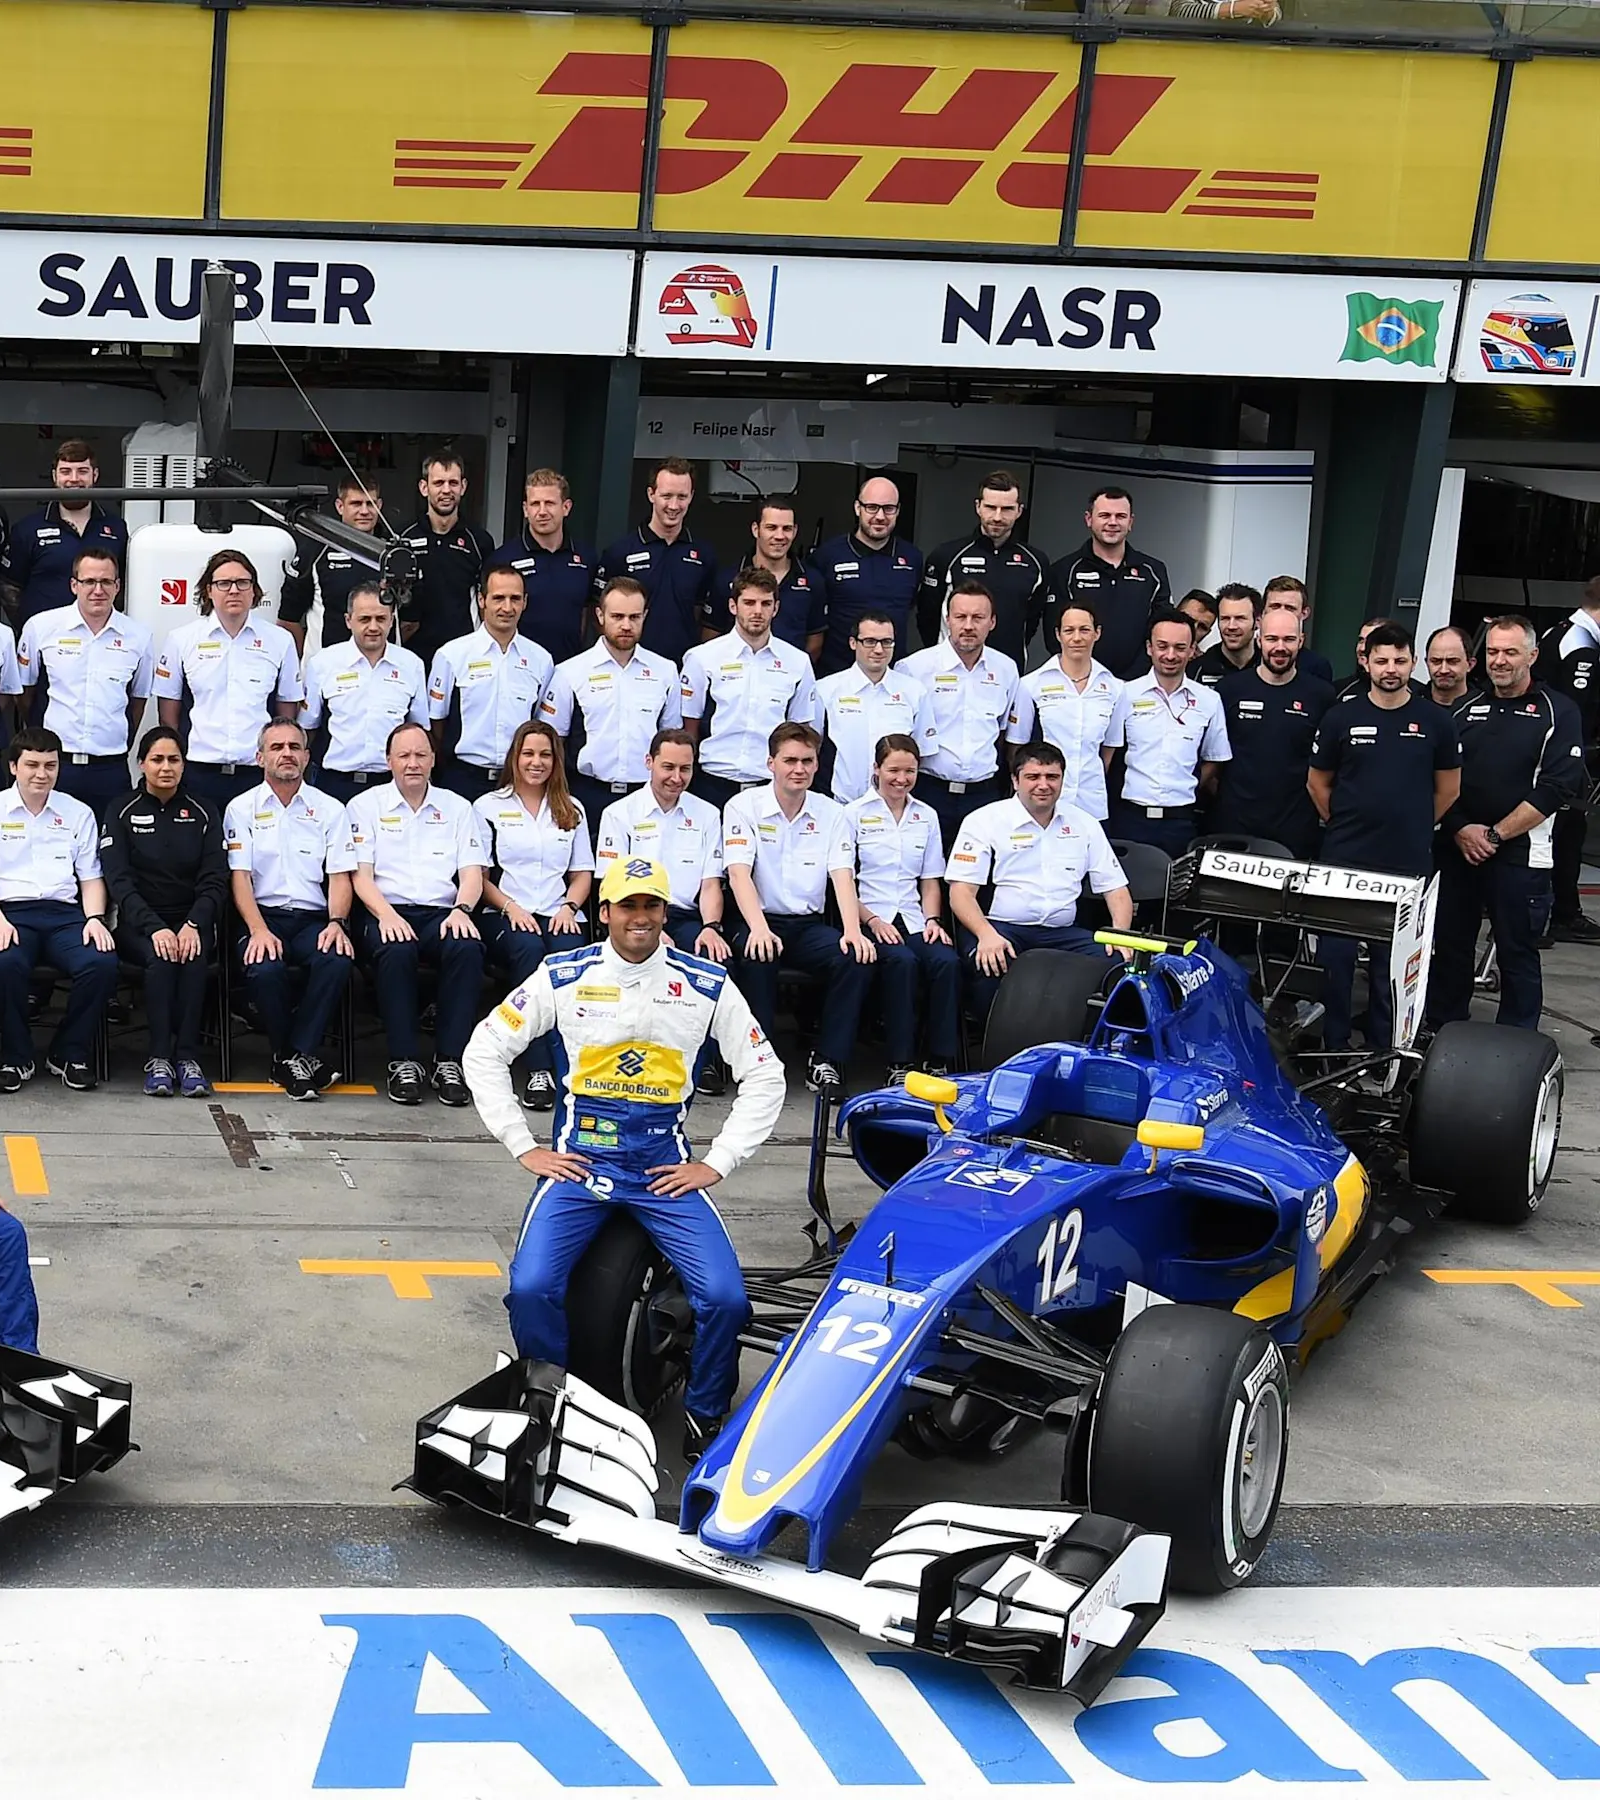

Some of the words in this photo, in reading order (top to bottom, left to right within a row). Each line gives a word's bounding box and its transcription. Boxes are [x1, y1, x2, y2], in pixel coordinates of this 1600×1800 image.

[515, 52, 1204, 215] DHL
[37, 252, 376, 326] SAUBER
[941, 283, 1162, 352] NASR
[648, 421, 663, 434] 12
[693, 422, 738, 439] Felipe
[741, 422, 777, 437] Nasr
[1304, 864, 1332, 887] F1
[584, 1078, 620, 1092] BANCO
[621, 1083, 636, 1094] DO
[636, 1083, 670, 1097] BRASIL
[1036, 1207, 1083, 1306] 12
[815, 1314, 892, 1366] 12
[715, 1555, 764, 1573] ACTION
